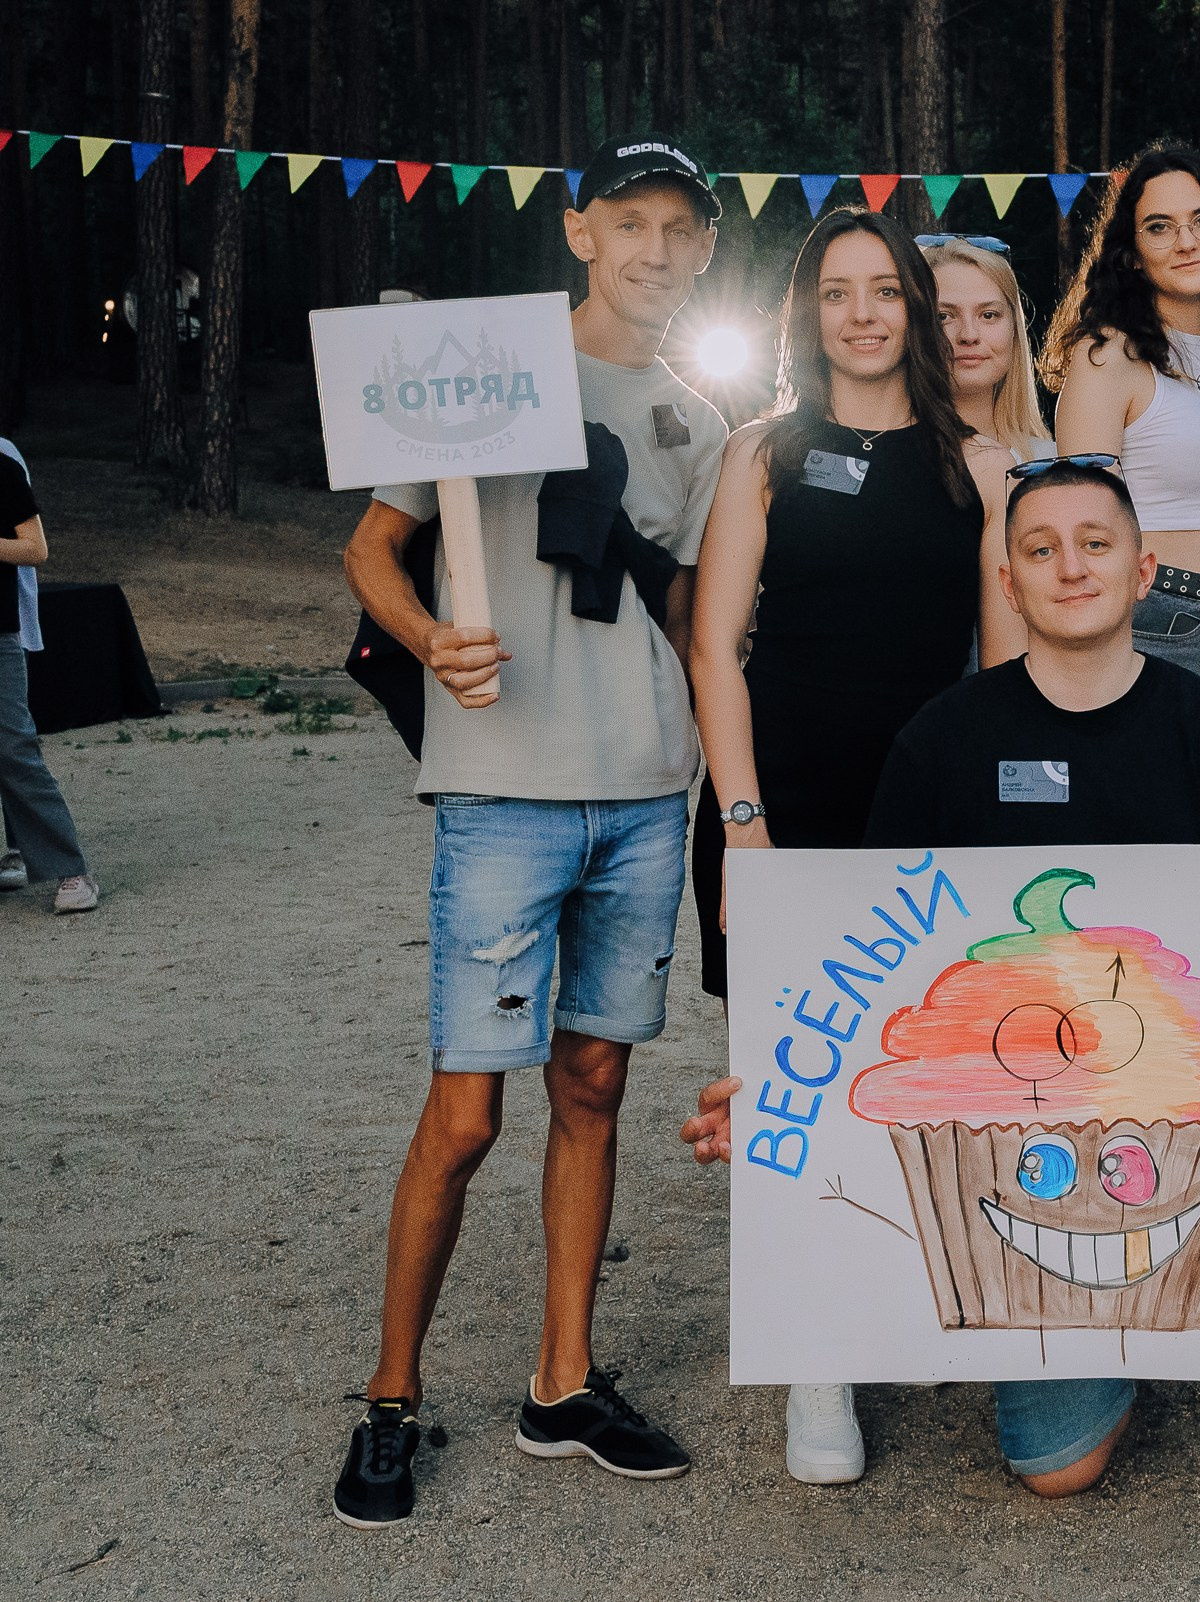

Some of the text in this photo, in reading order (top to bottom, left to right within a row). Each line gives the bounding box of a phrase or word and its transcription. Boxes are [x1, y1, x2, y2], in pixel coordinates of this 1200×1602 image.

[616, 142, 698, 174] GODBLESS
[362, 371, 541, 414] 8 ОТРЯД
[395, 430, 516, 462] СМЕНА 2023
[746, 850, 972, 1179] ВЕСЁЛЫЙ
